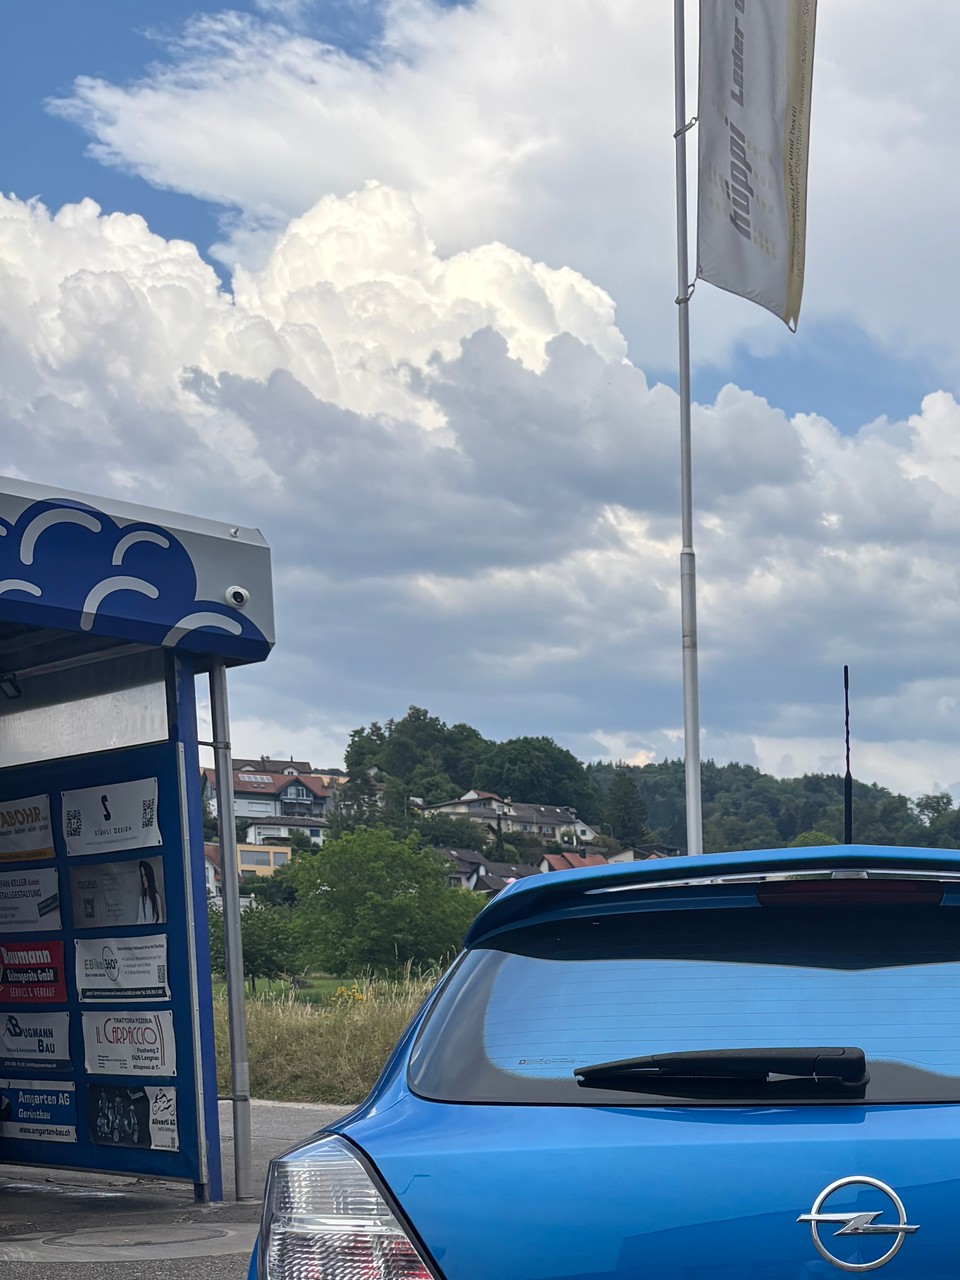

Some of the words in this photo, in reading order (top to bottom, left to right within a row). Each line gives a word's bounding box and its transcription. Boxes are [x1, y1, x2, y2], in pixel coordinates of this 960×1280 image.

[730, 16, 745, 108] Leder
[789, 105, 798, 135] Textil
[788, 161, 796, 192] Leder
[18, 1091, 57, 1106] Amgarten
[58, 1093, 70, 1106] AG
[18, 1108, 51, 1120] Gerüstbau
